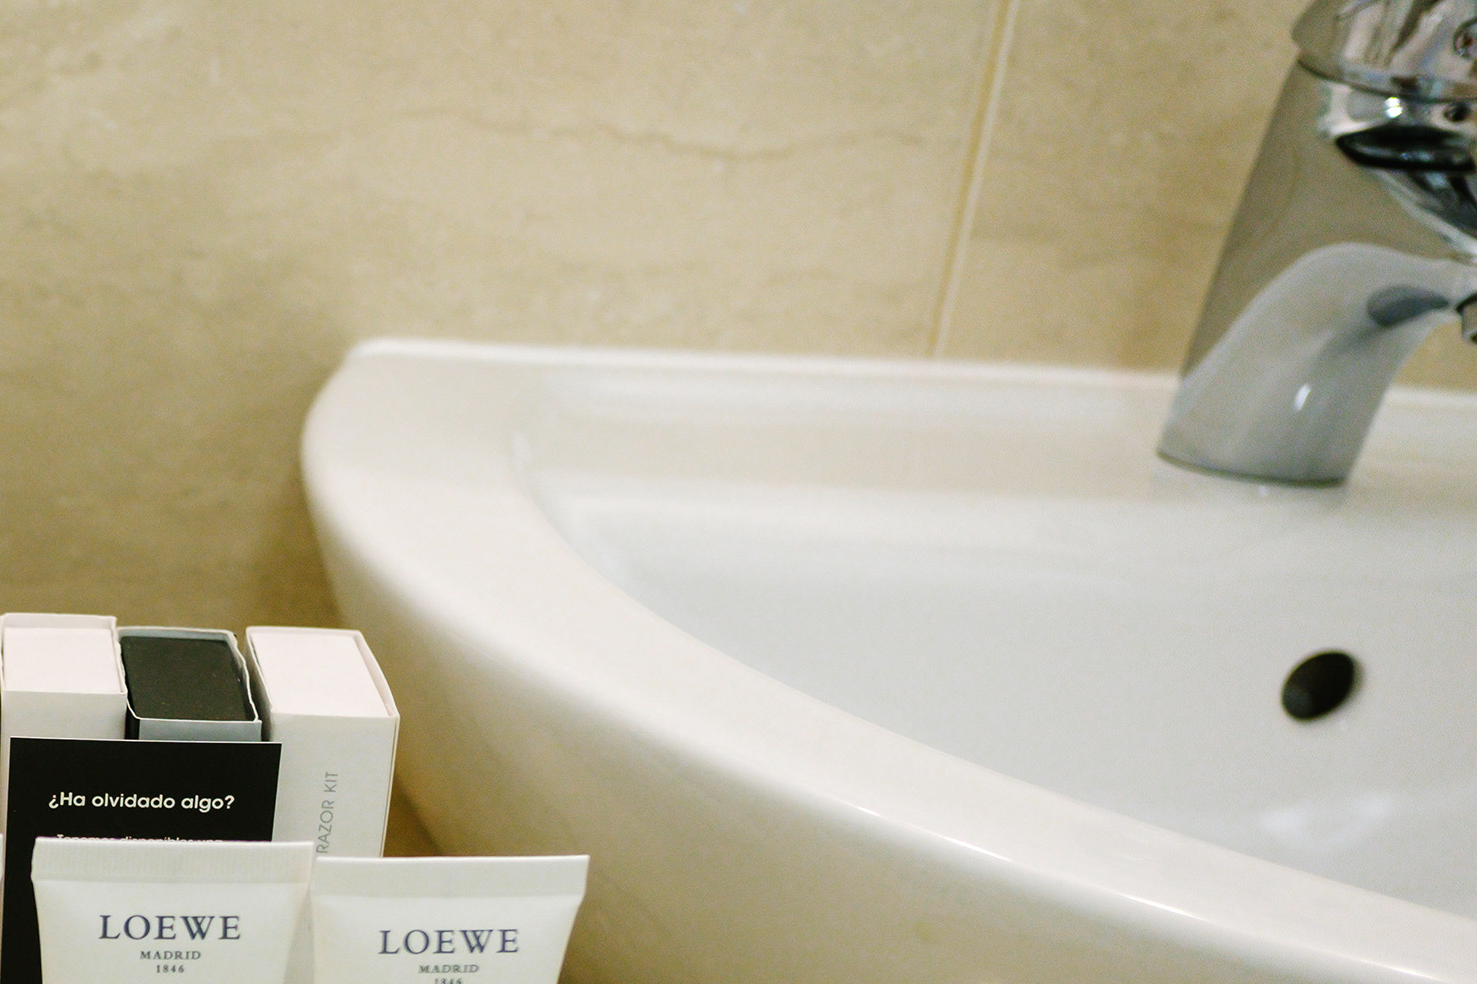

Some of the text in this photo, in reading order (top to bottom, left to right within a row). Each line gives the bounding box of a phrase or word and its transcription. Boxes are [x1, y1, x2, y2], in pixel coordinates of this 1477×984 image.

[48, 791, 235, 813] ¿Ha olvidado algo?
[316, 771, 338, 853] RAZOR KIT
[98, 914, 241, 940] LOEWE
[378, 929, 520, 954] LOEWE
[140, 951, 201, 960] MADRID
[156, 965, 185, 973] 1846
[419, 964, 480, 973] MADRID
